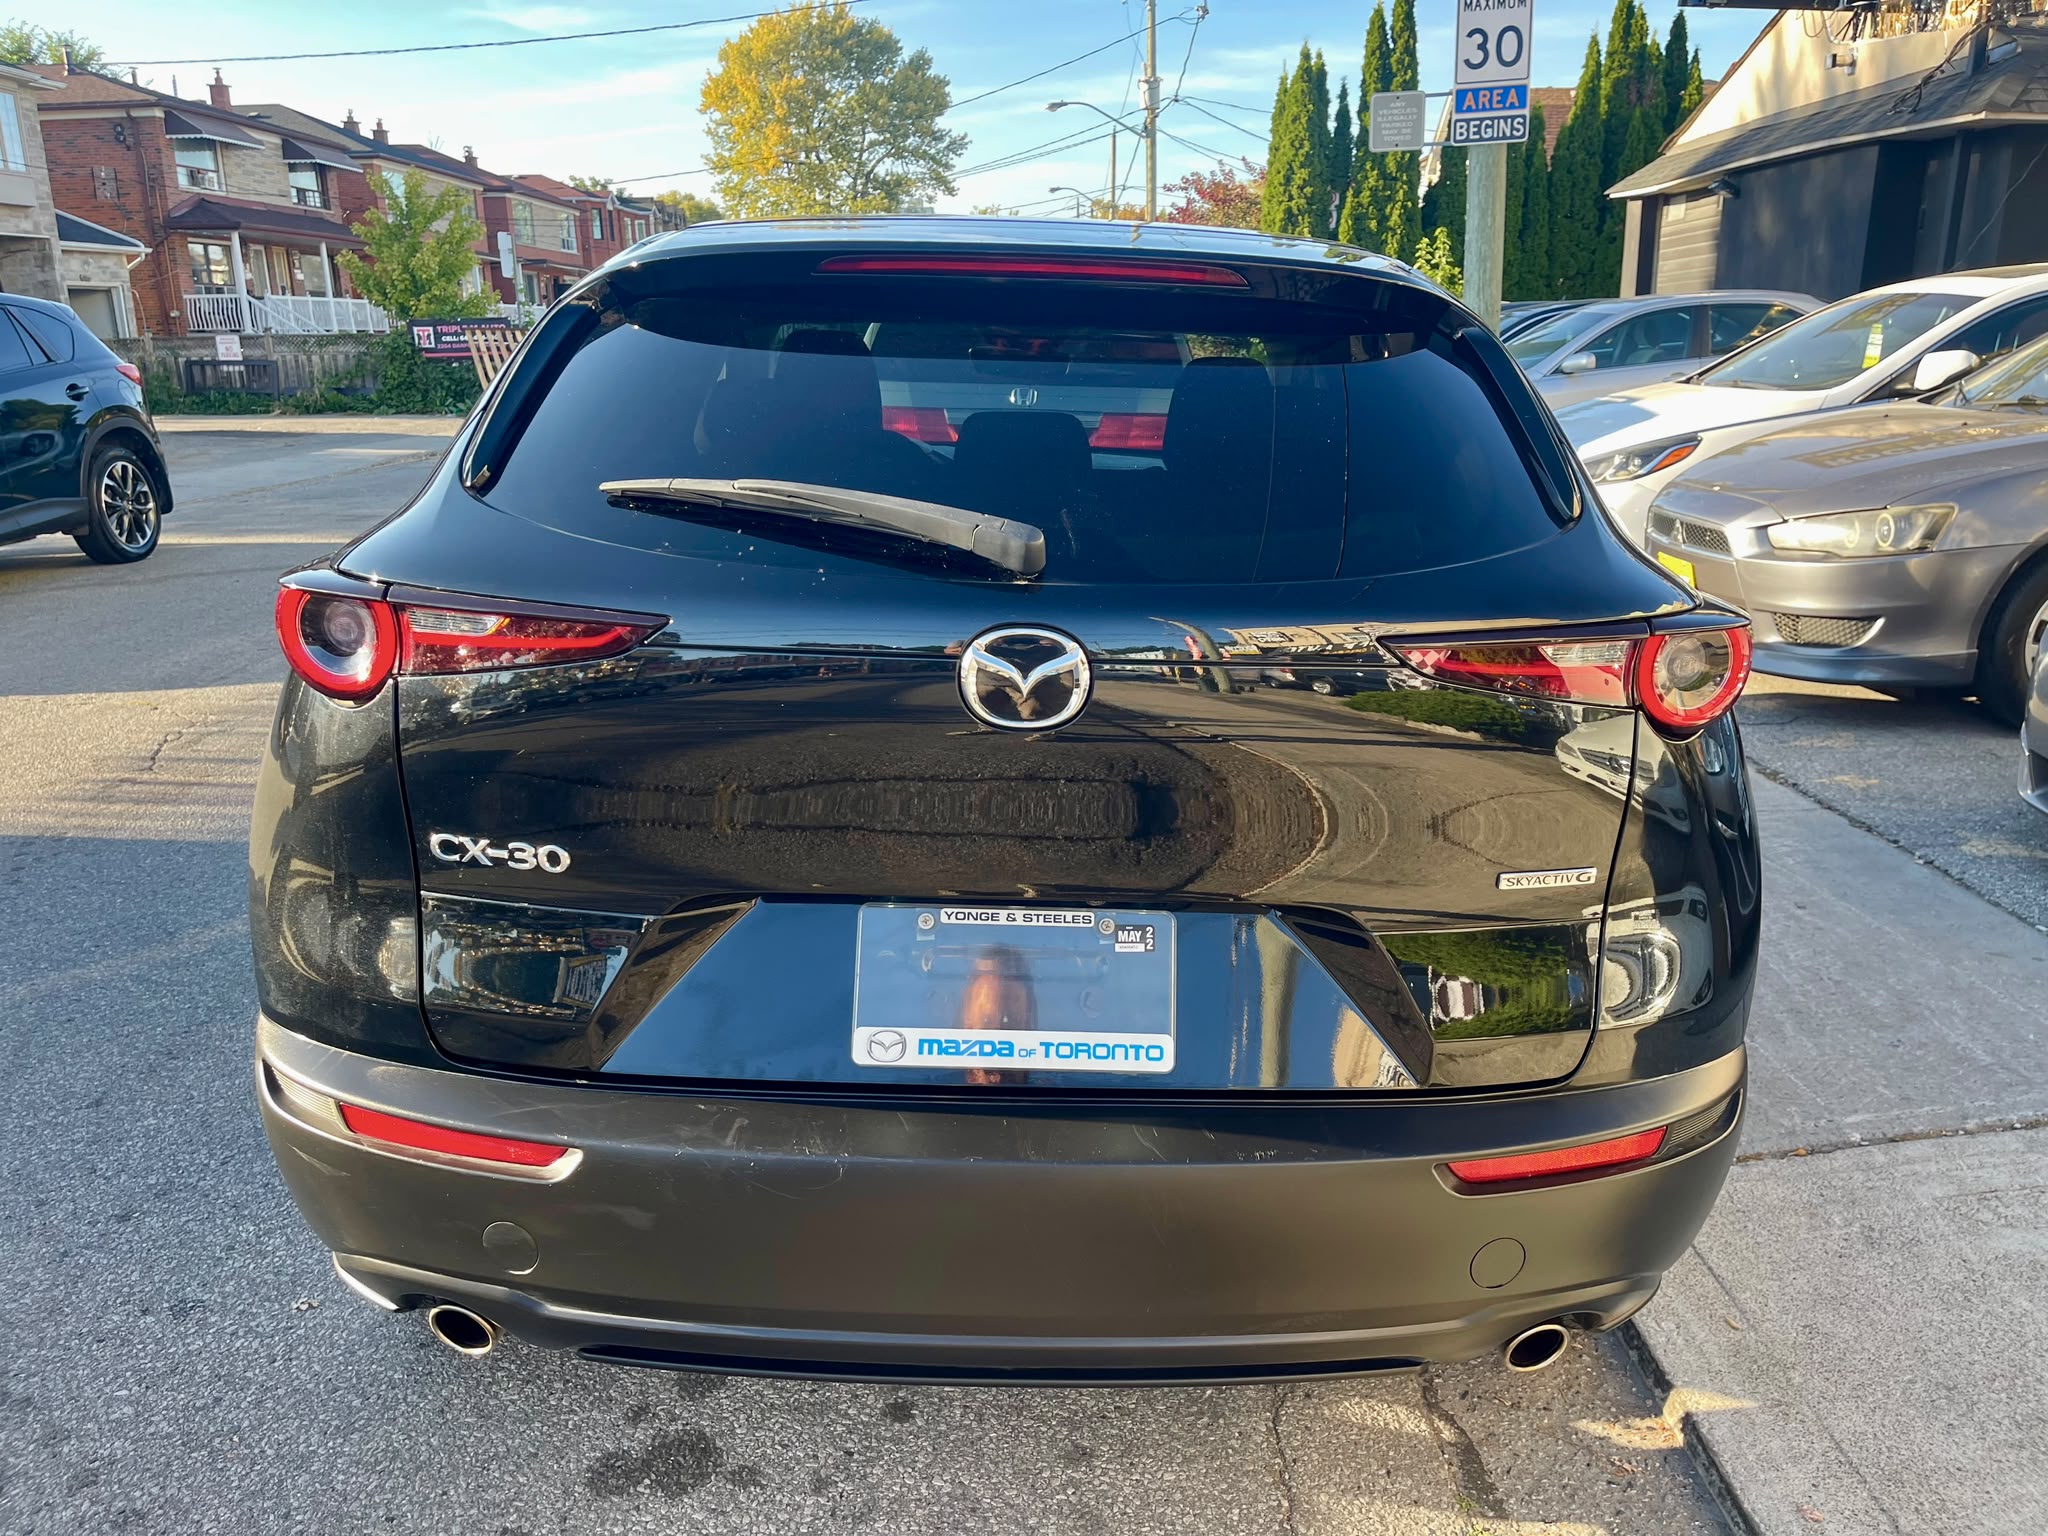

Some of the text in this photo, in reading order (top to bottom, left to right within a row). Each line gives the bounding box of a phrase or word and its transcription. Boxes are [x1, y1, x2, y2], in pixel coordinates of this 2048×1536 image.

[1463, 0, 1527, 12] MAXIMUM
[1463, 25, 1524, 70] 30
[1462, 88, 1520, 111] AREA
[1456, 117, 1525, 141] BEGINS
[430, 833, 571, 874] CX-30
[945, 911, 1093, 925] YONGE & STEELES
[1117, 930, 1142, 943] MAY
[918, 1037, 1165, 1062] mazda OF TORONTO
